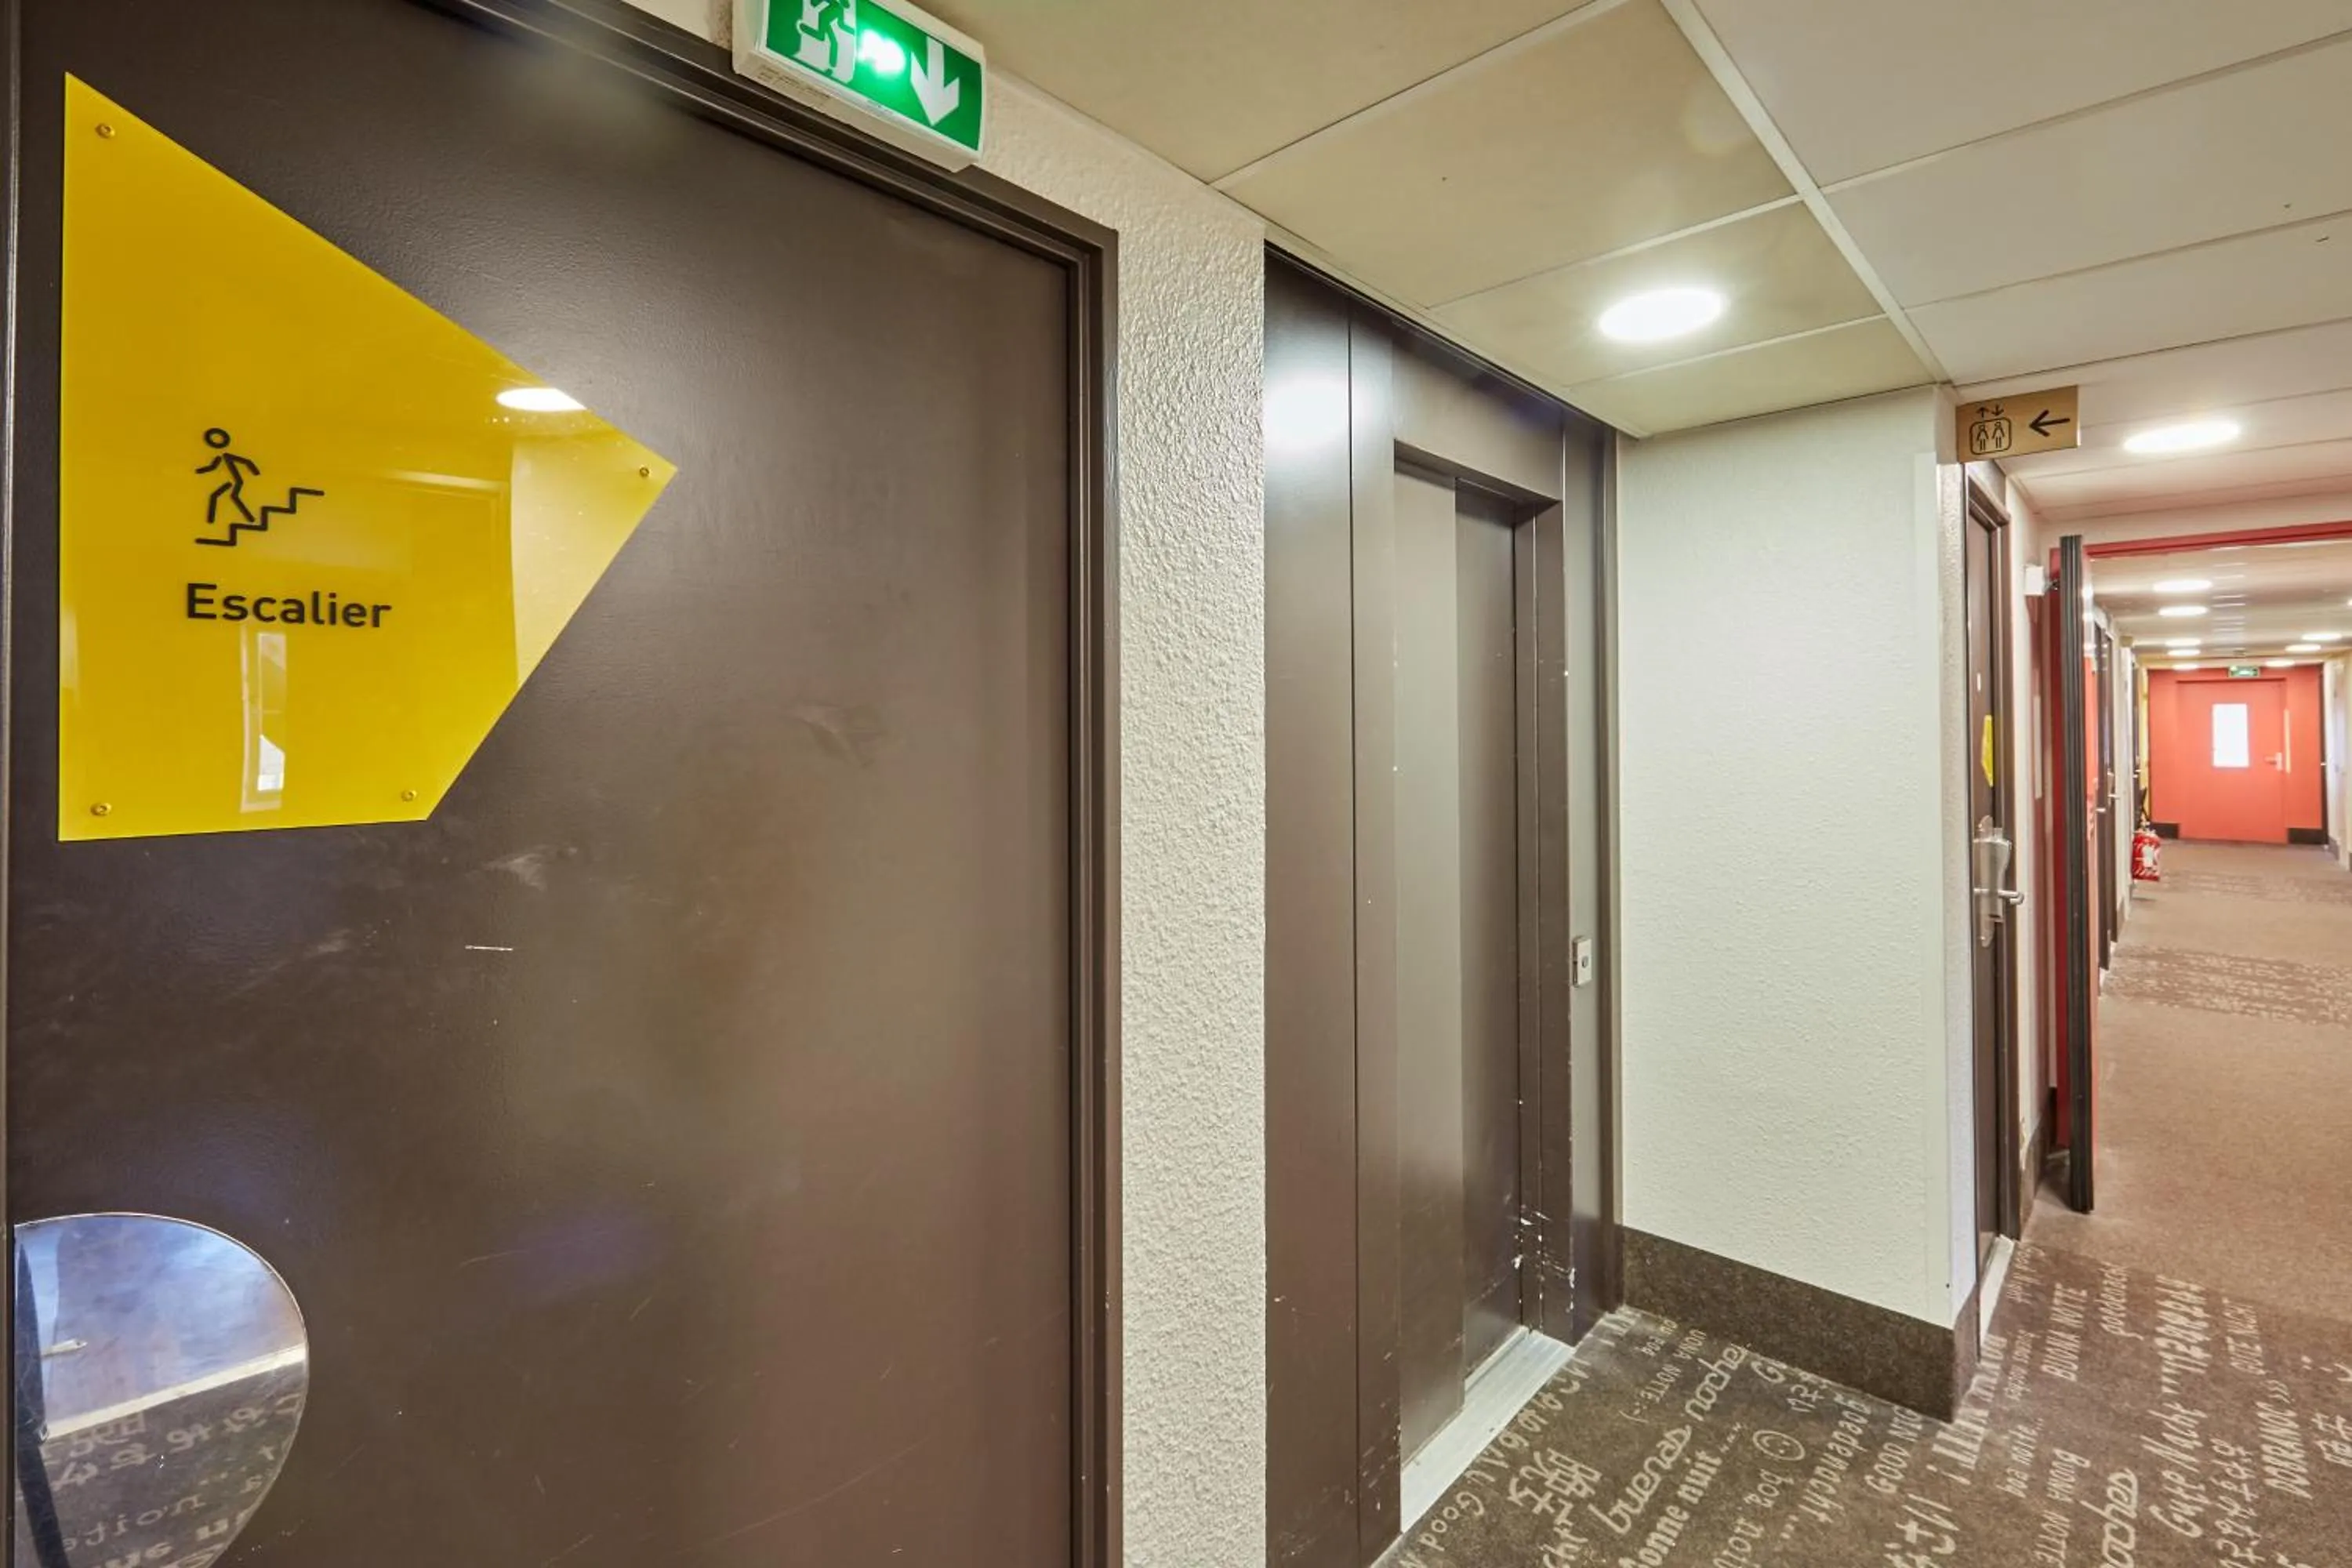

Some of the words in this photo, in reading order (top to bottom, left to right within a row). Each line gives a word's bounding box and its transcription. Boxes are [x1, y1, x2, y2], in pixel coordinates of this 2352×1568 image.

[186, 583, 393, 628] Escalier
[2049, 1283, 2087, 1327] NOTTE
[2041, 1330, 2080, 1382] BUONA
[1588, 1425, 1692, 1534] buenas
[1685, 1342, 1748, 1421] noche
[2140, 1401, 2208, 1473] Nacht
[2256, 1402, 2313, 1499] DOBRANOC
[1865, 1443, 1907, 1494] GOOD
[1995, 1468, 2028, 1498] boa
[1418, 1490, 1485, 1552] Good
[2079, 1468, 2138, 1568] oches
[2149, 1470, 2211, 1538] Gute
